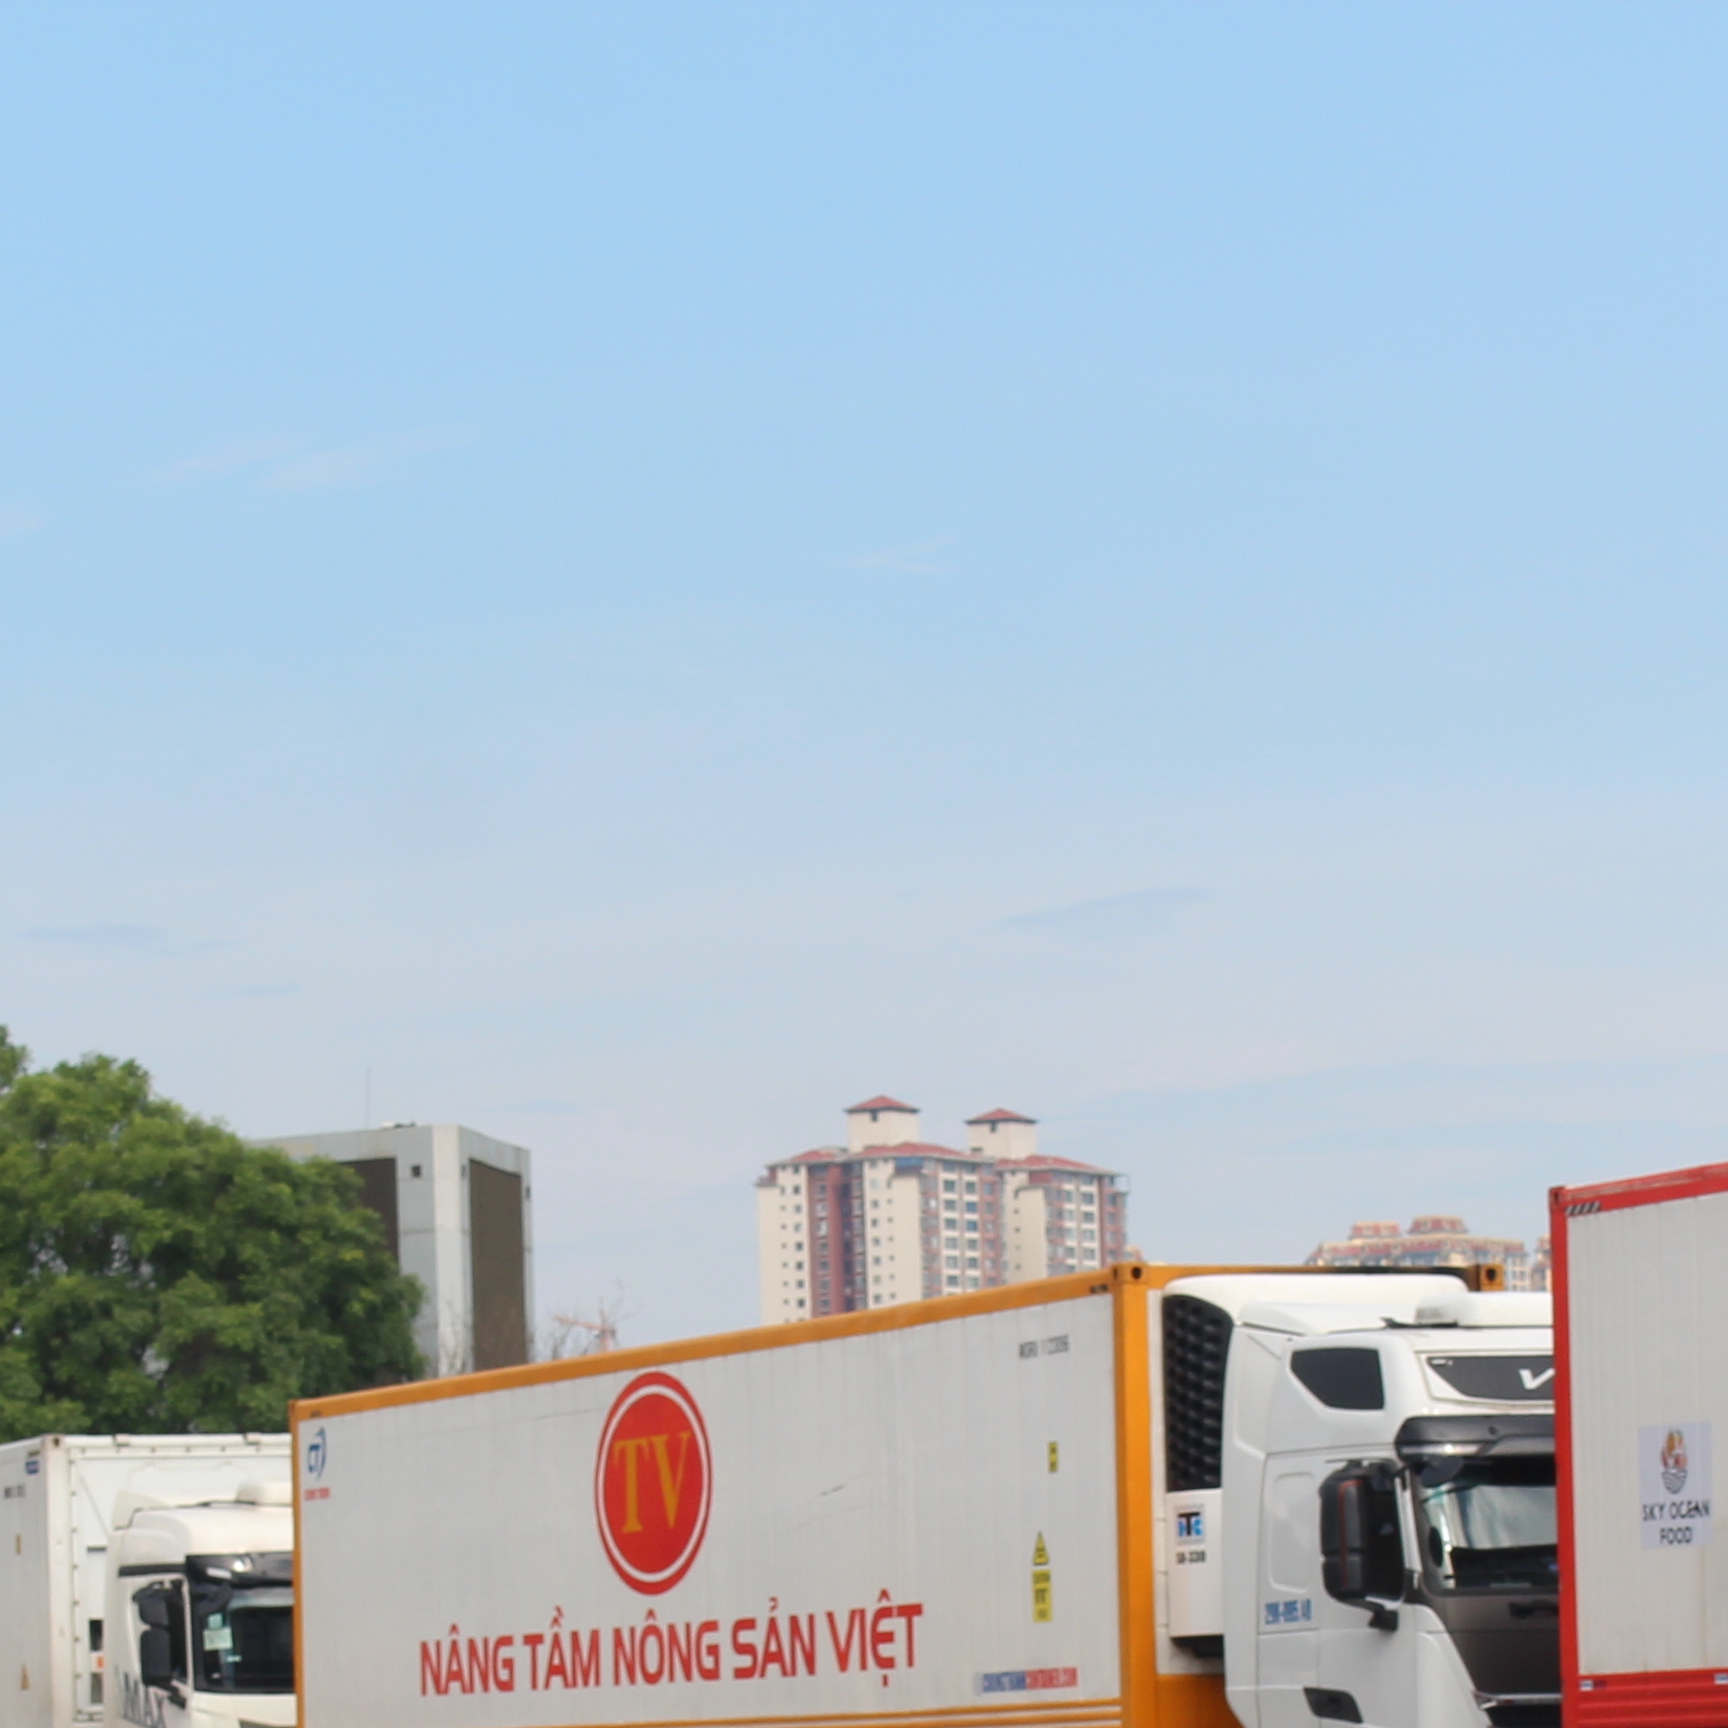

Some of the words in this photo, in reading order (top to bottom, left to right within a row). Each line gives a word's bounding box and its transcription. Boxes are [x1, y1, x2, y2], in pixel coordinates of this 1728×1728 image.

[613, 1431, 692, 1532] TV
[1669, 1500, 1711, 1520] OCEAN
[1659, 1526, 1693, 1545] FOOD
[420, 1624, 515, 1696] NÂNG
[523, 1606, 601, 1691] TẦM
[613, 1609, 721, 1686] NÔNG
[731, 1597, 817, 1680] SẢN
[826, 1589, 924, 1687] VIỆT
